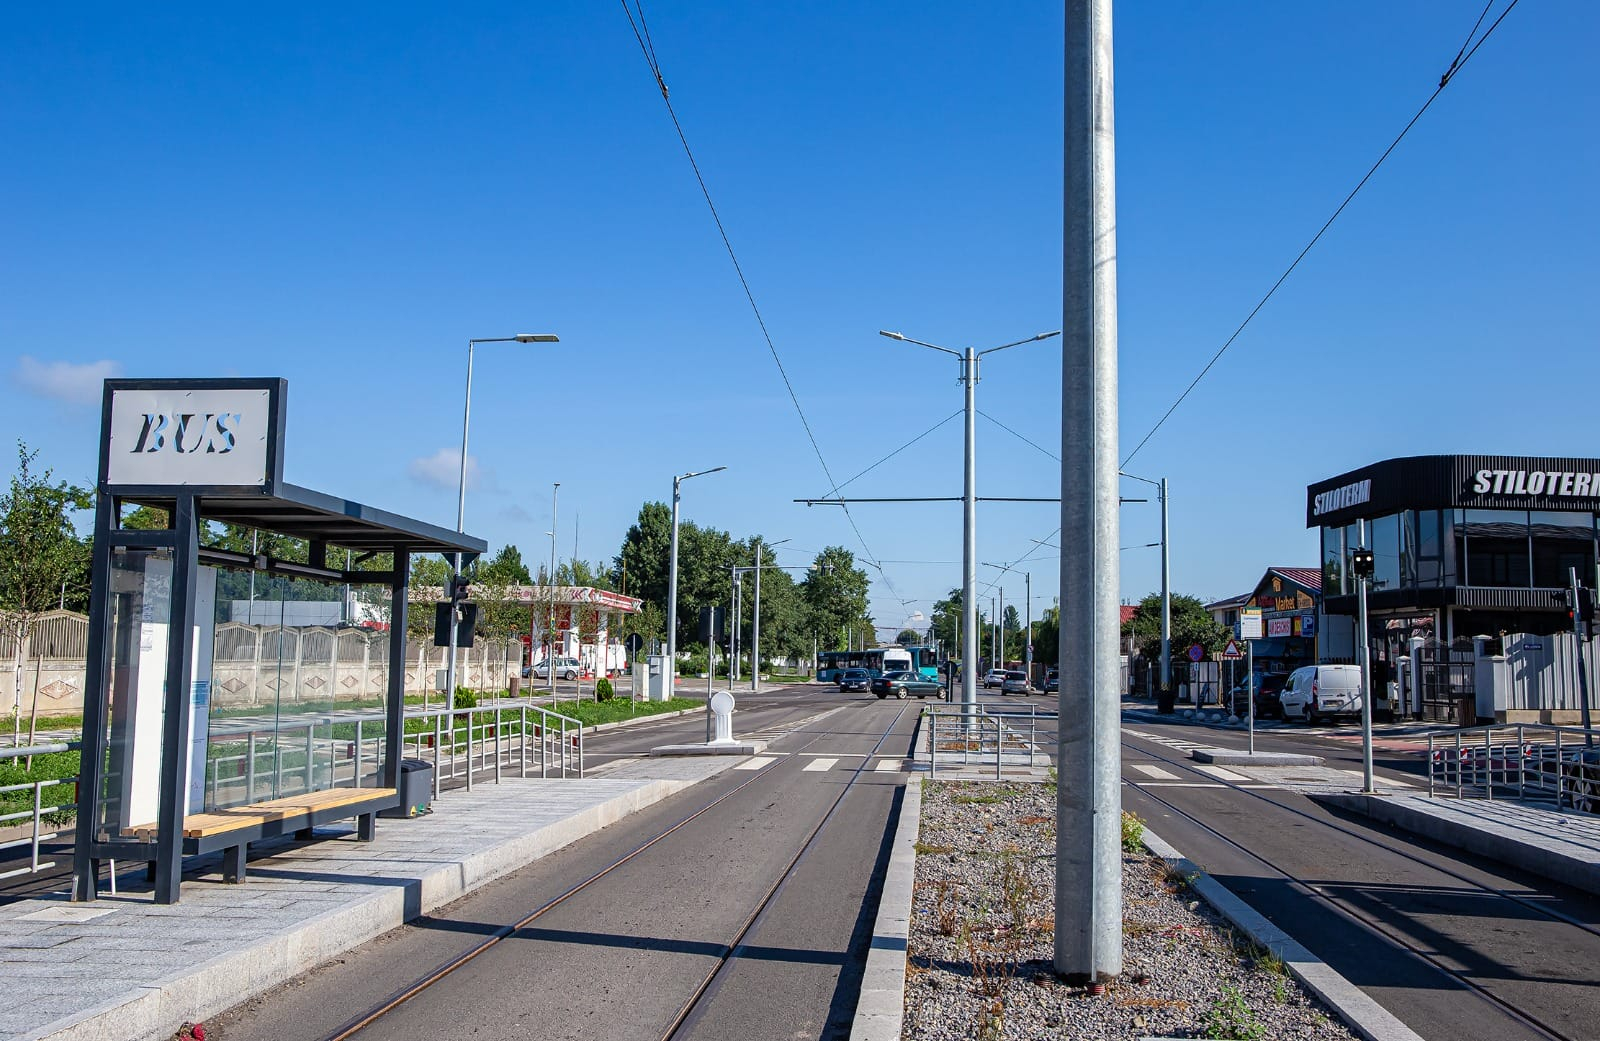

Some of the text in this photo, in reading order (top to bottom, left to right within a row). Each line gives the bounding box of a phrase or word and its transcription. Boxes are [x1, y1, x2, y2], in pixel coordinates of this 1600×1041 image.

[129, 413, 242, 454] BUS
[1313, 478, 1372, 516] STILOTERM
[1275, 596, 1295, 611] Market
[1303, 617, 1313, 628] P
